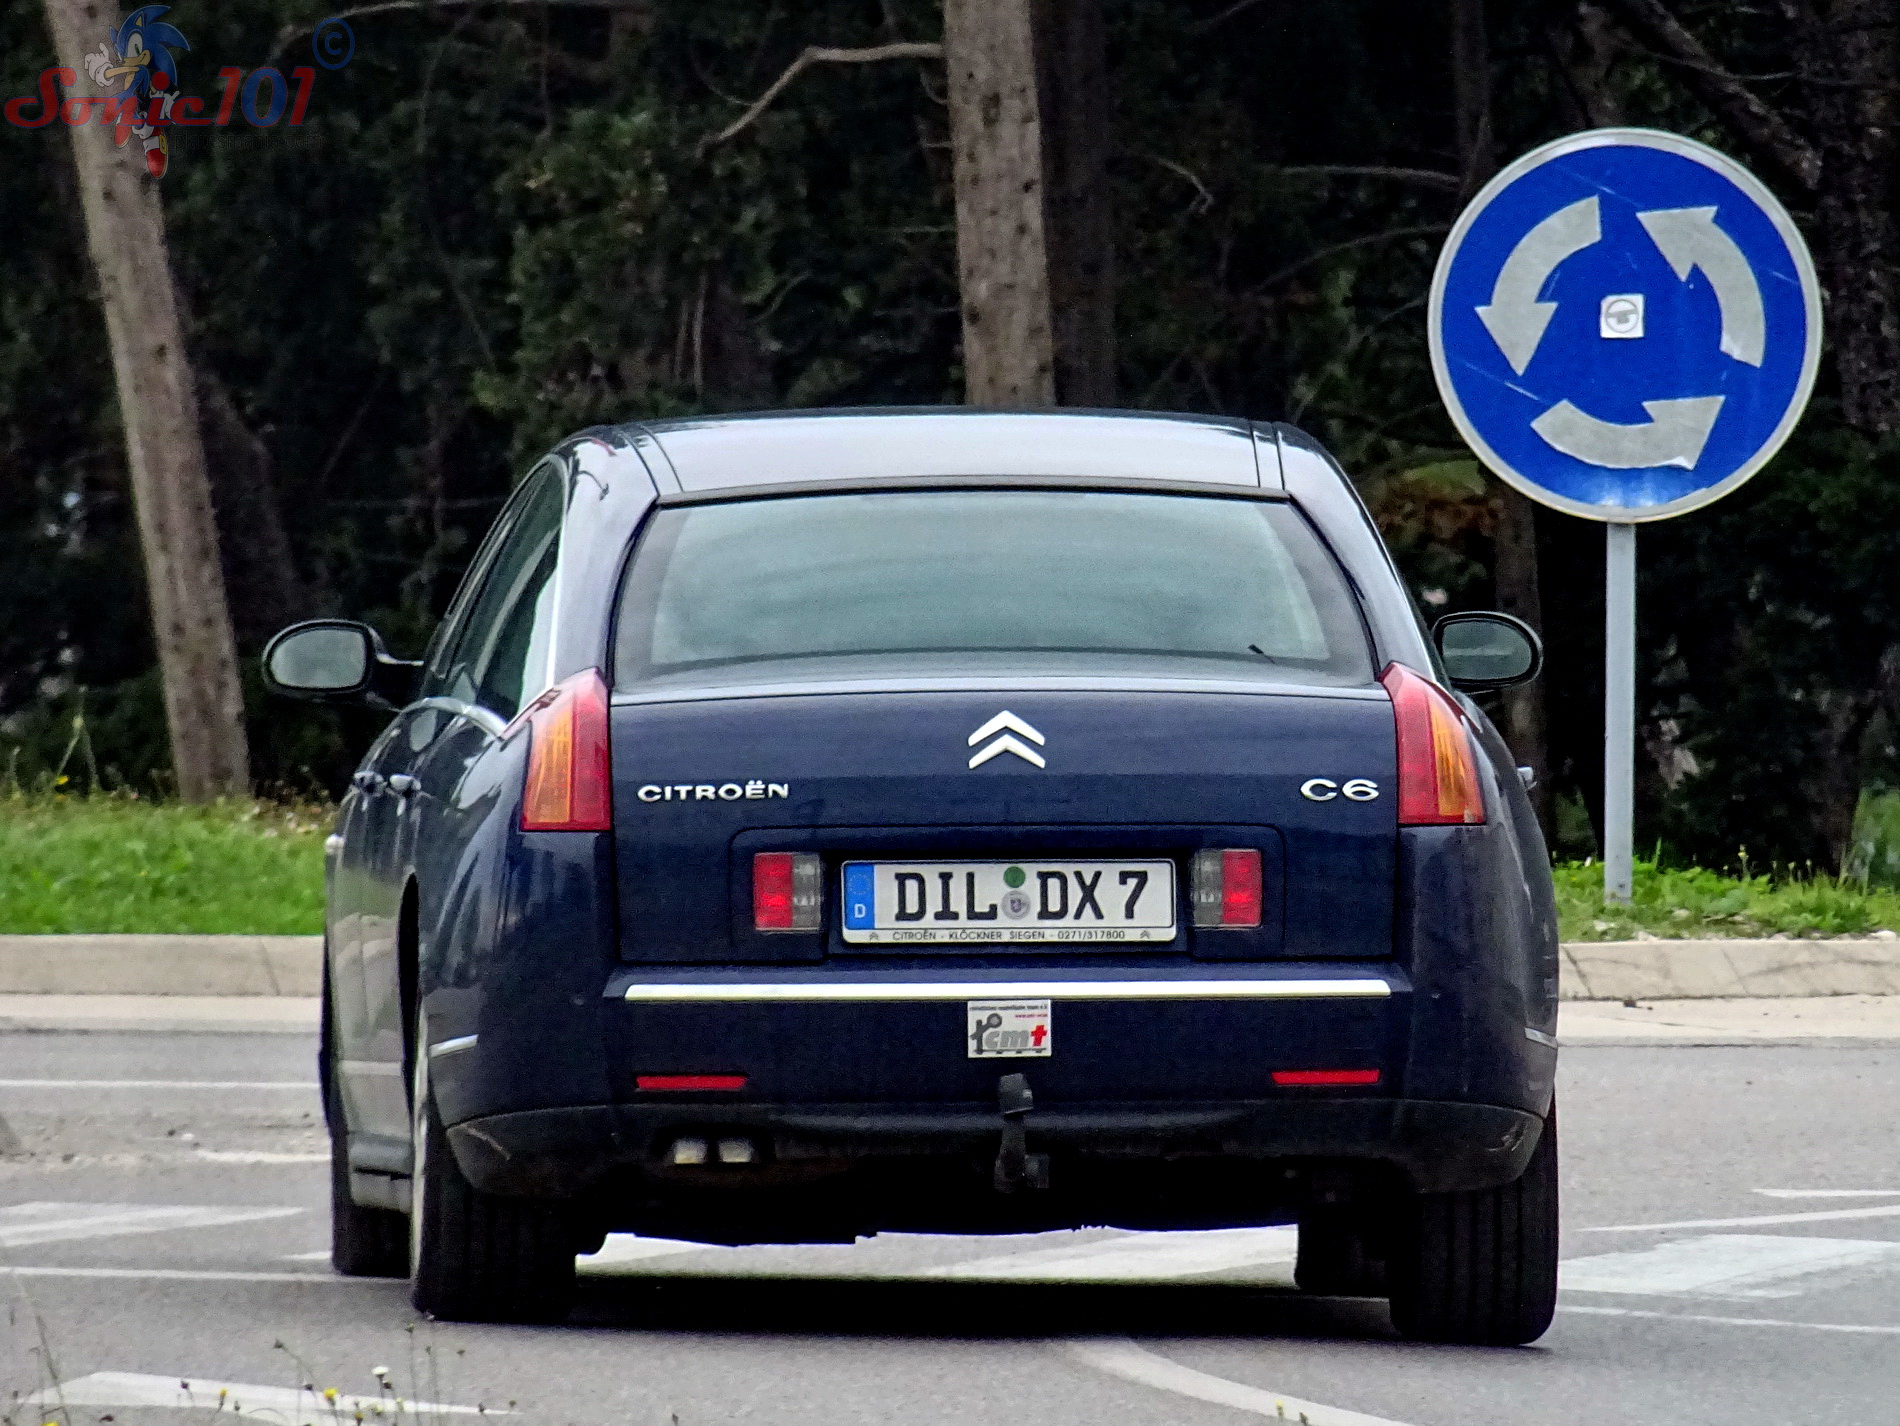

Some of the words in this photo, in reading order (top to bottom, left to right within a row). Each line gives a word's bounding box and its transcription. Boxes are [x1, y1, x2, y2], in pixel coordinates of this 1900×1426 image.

[637, 780, 789, 802] CITROËN
[1300, 778, 1379, 801] C6
[894, 871, 999, 921] DIL
[1036, 870, 1105, 920] DX
[1118, 870, 1149, 920] 7
[854, 903, 866, 919] D
[892, 929, 936, 941] CITROËN
[948, 929, 1003, 940] KLÖCKNER
[1009, 930, 1045, 940] SIEGEN
[1057, 930, 1125, 940] 0271/317800
